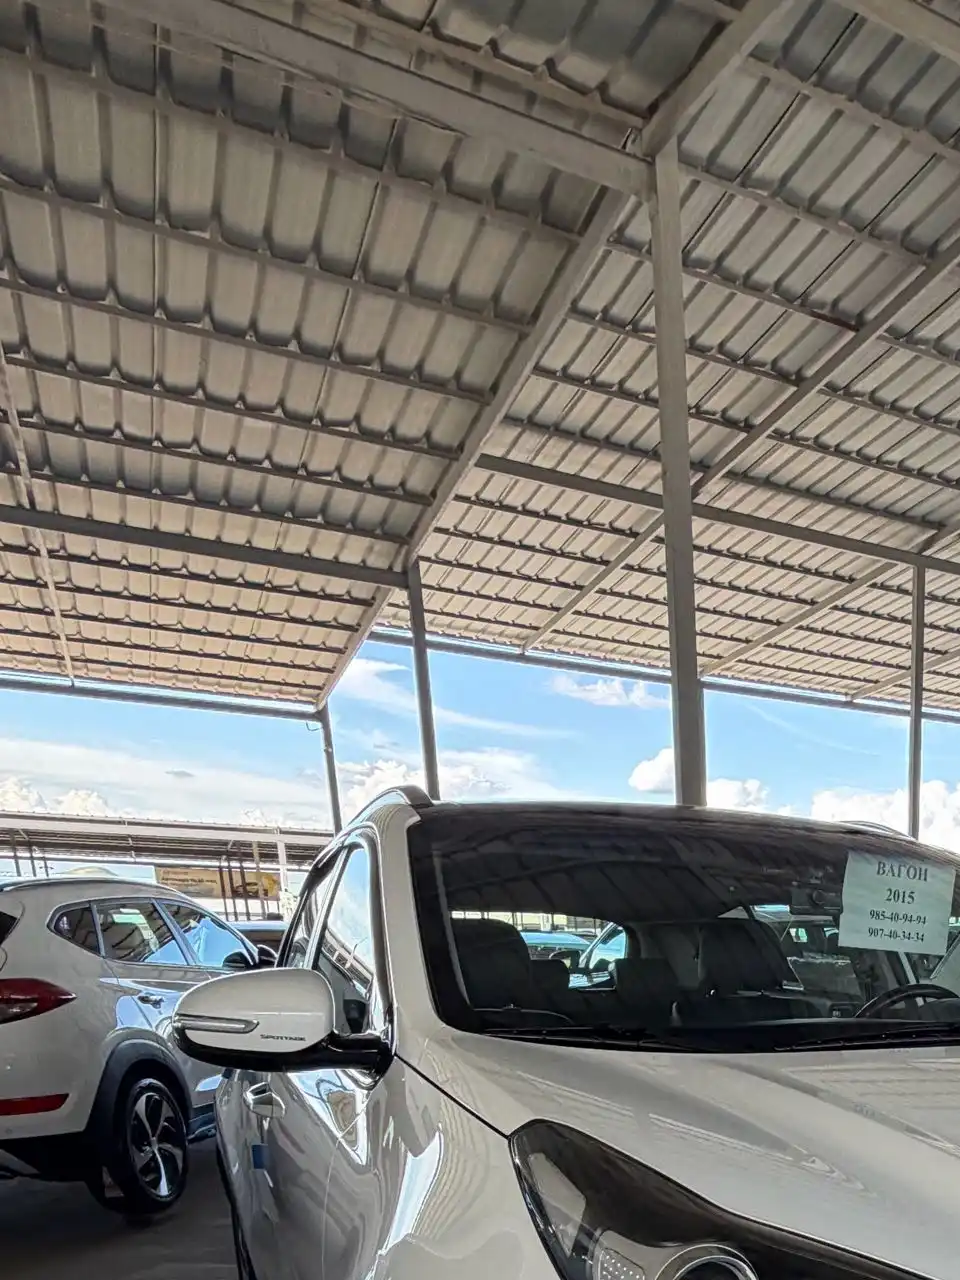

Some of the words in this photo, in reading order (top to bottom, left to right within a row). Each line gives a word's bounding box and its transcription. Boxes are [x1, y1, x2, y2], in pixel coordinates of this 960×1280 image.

[876, 861, 929, 882] ВАГОН
[885, 888, 916, 905] 2015
[869, 909, 927, 925] 985-40-94-94
[868, 927, 925, 942] 907-40-34-34
